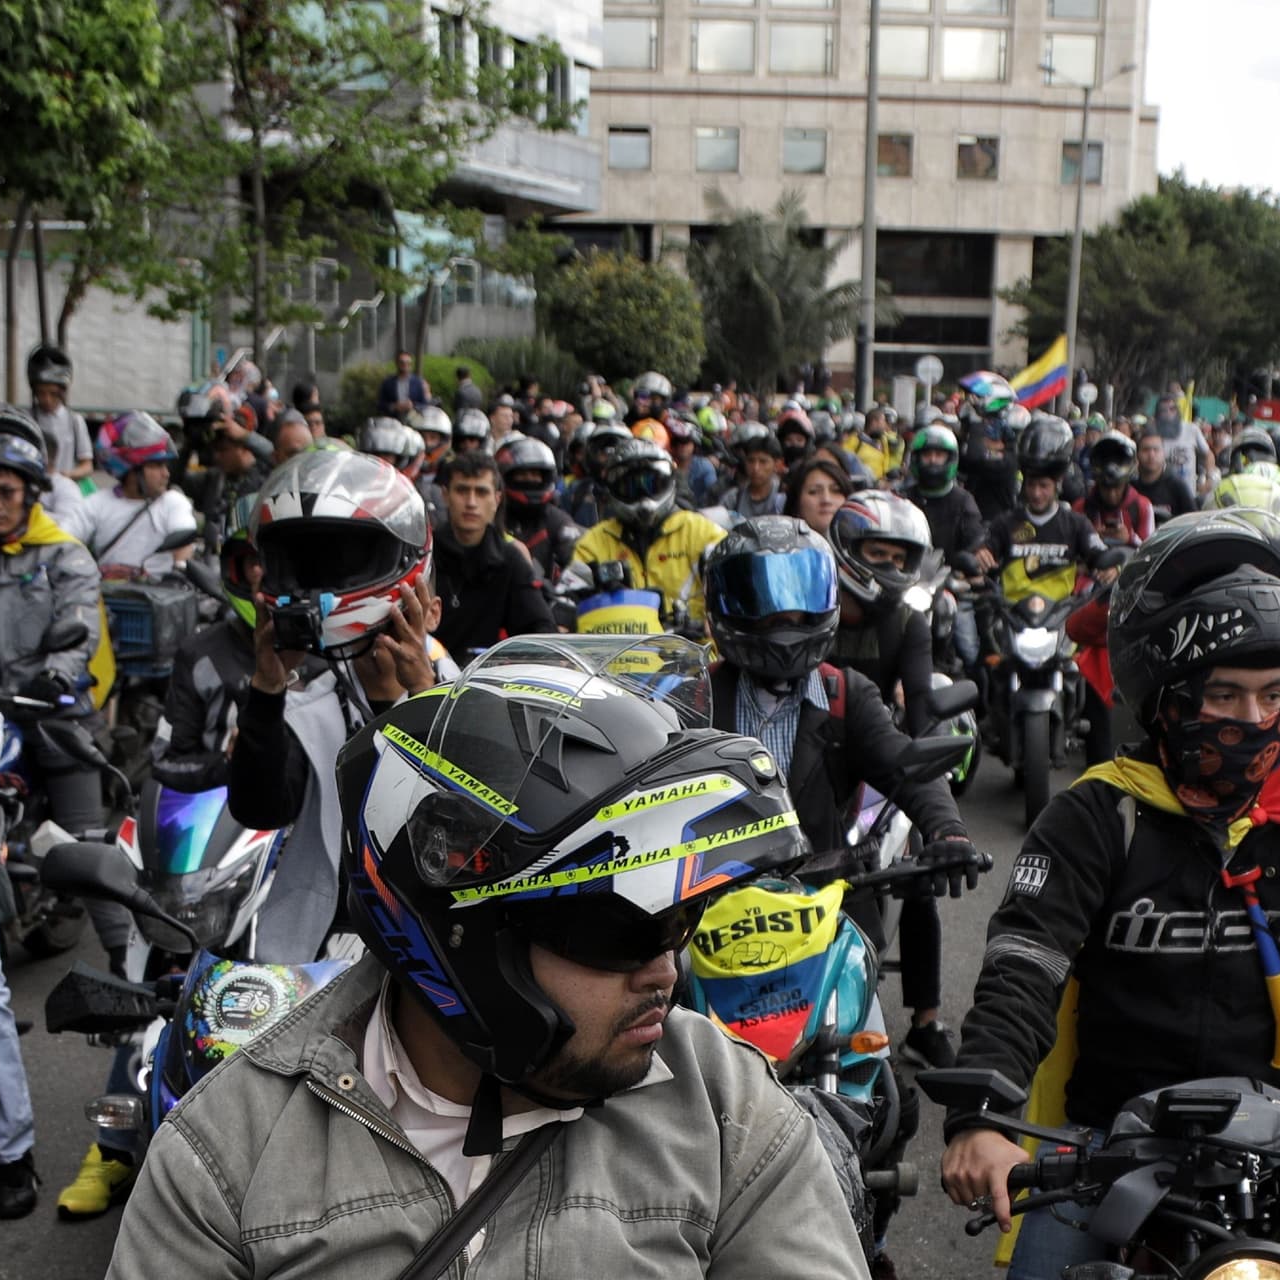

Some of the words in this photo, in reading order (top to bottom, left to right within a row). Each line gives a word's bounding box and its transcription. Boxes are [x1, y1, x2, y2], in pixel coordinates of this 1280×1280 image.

[448, 766, 514, 815] YAMAHA
[623, 780, 707, 812] YAMAHA
[706, 814, 786, 846] YAMAHA
[587, 846, 672, 876] YAMAHA
[474, 872, 553, 896] YAMAHA
